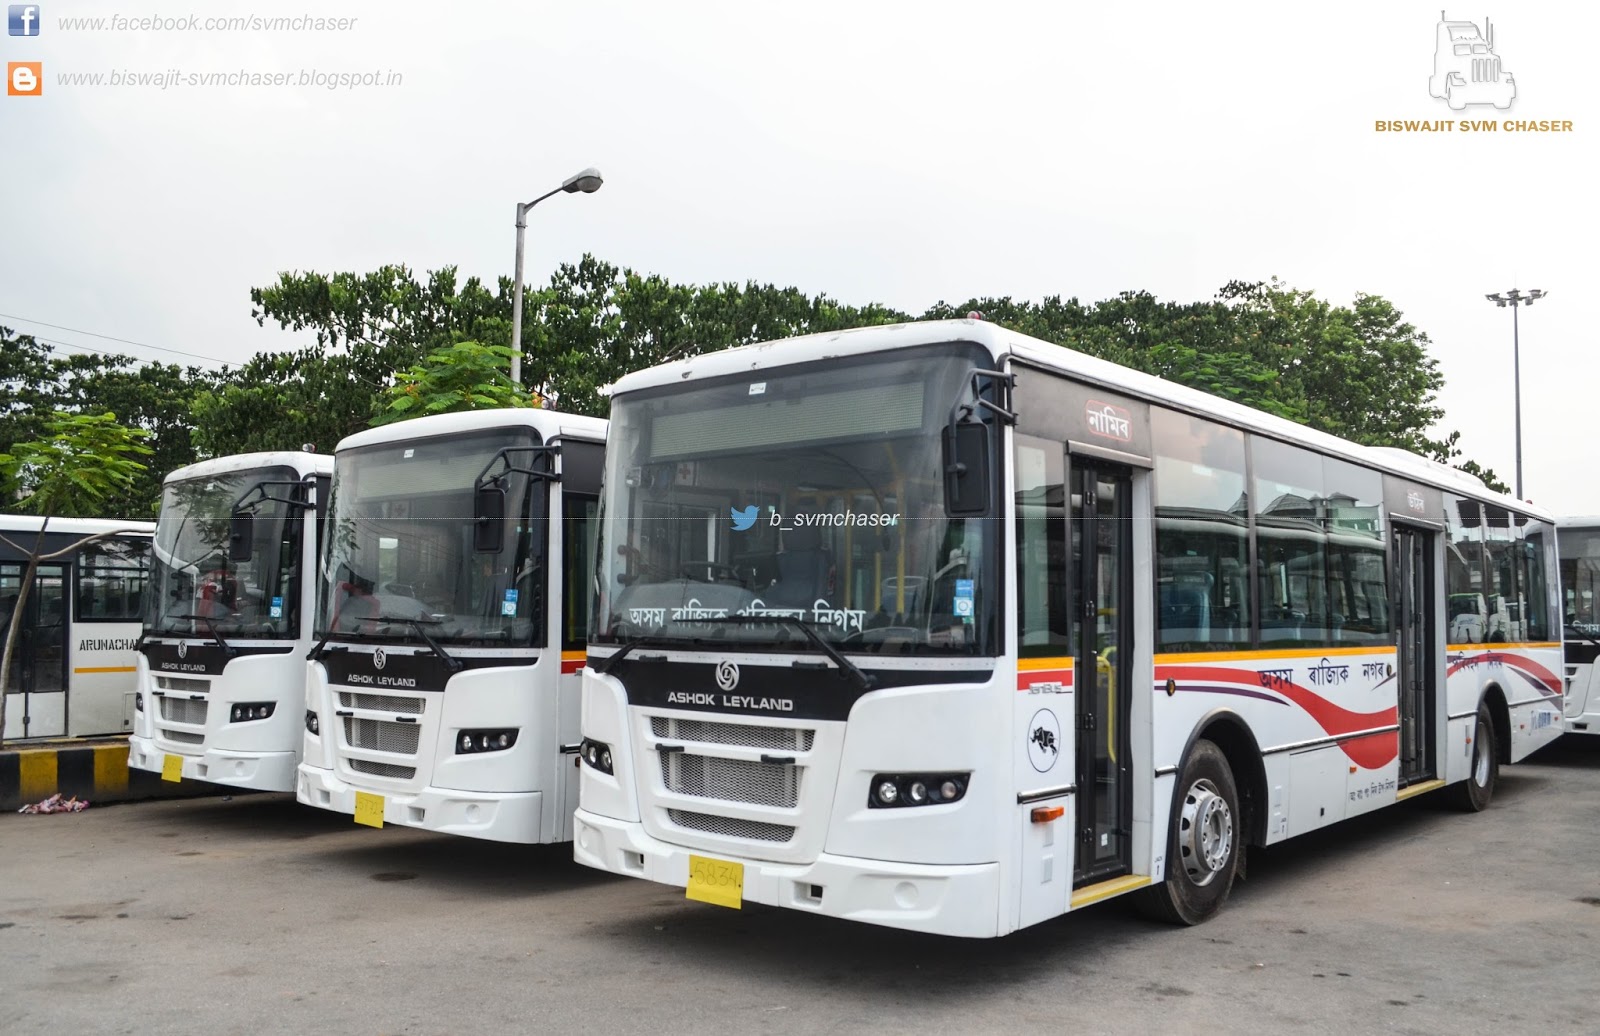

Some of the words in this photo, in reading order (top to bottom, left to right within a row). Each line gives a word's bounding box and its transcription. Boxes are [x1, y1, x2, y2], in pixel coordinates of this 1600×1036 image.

[629, 608, 666, 628] অসম
[812, 599, 866, 632] নিগম
[79, 638, 138, 651] ARUNACHA
[161, 662, 179, 670] ASHOK
[181, 663, 206, 671] LEYLAND
[348, 674, 374, 684] ASHOK
[378, 677, 416, 687] LEYLAND
[1257, 669, 1293, 689] অসম
[668, 692, 715, 705] ASHOK
[723, 695, 793, 711] LEYLAND
[695, 861, 737, 889] 5834
